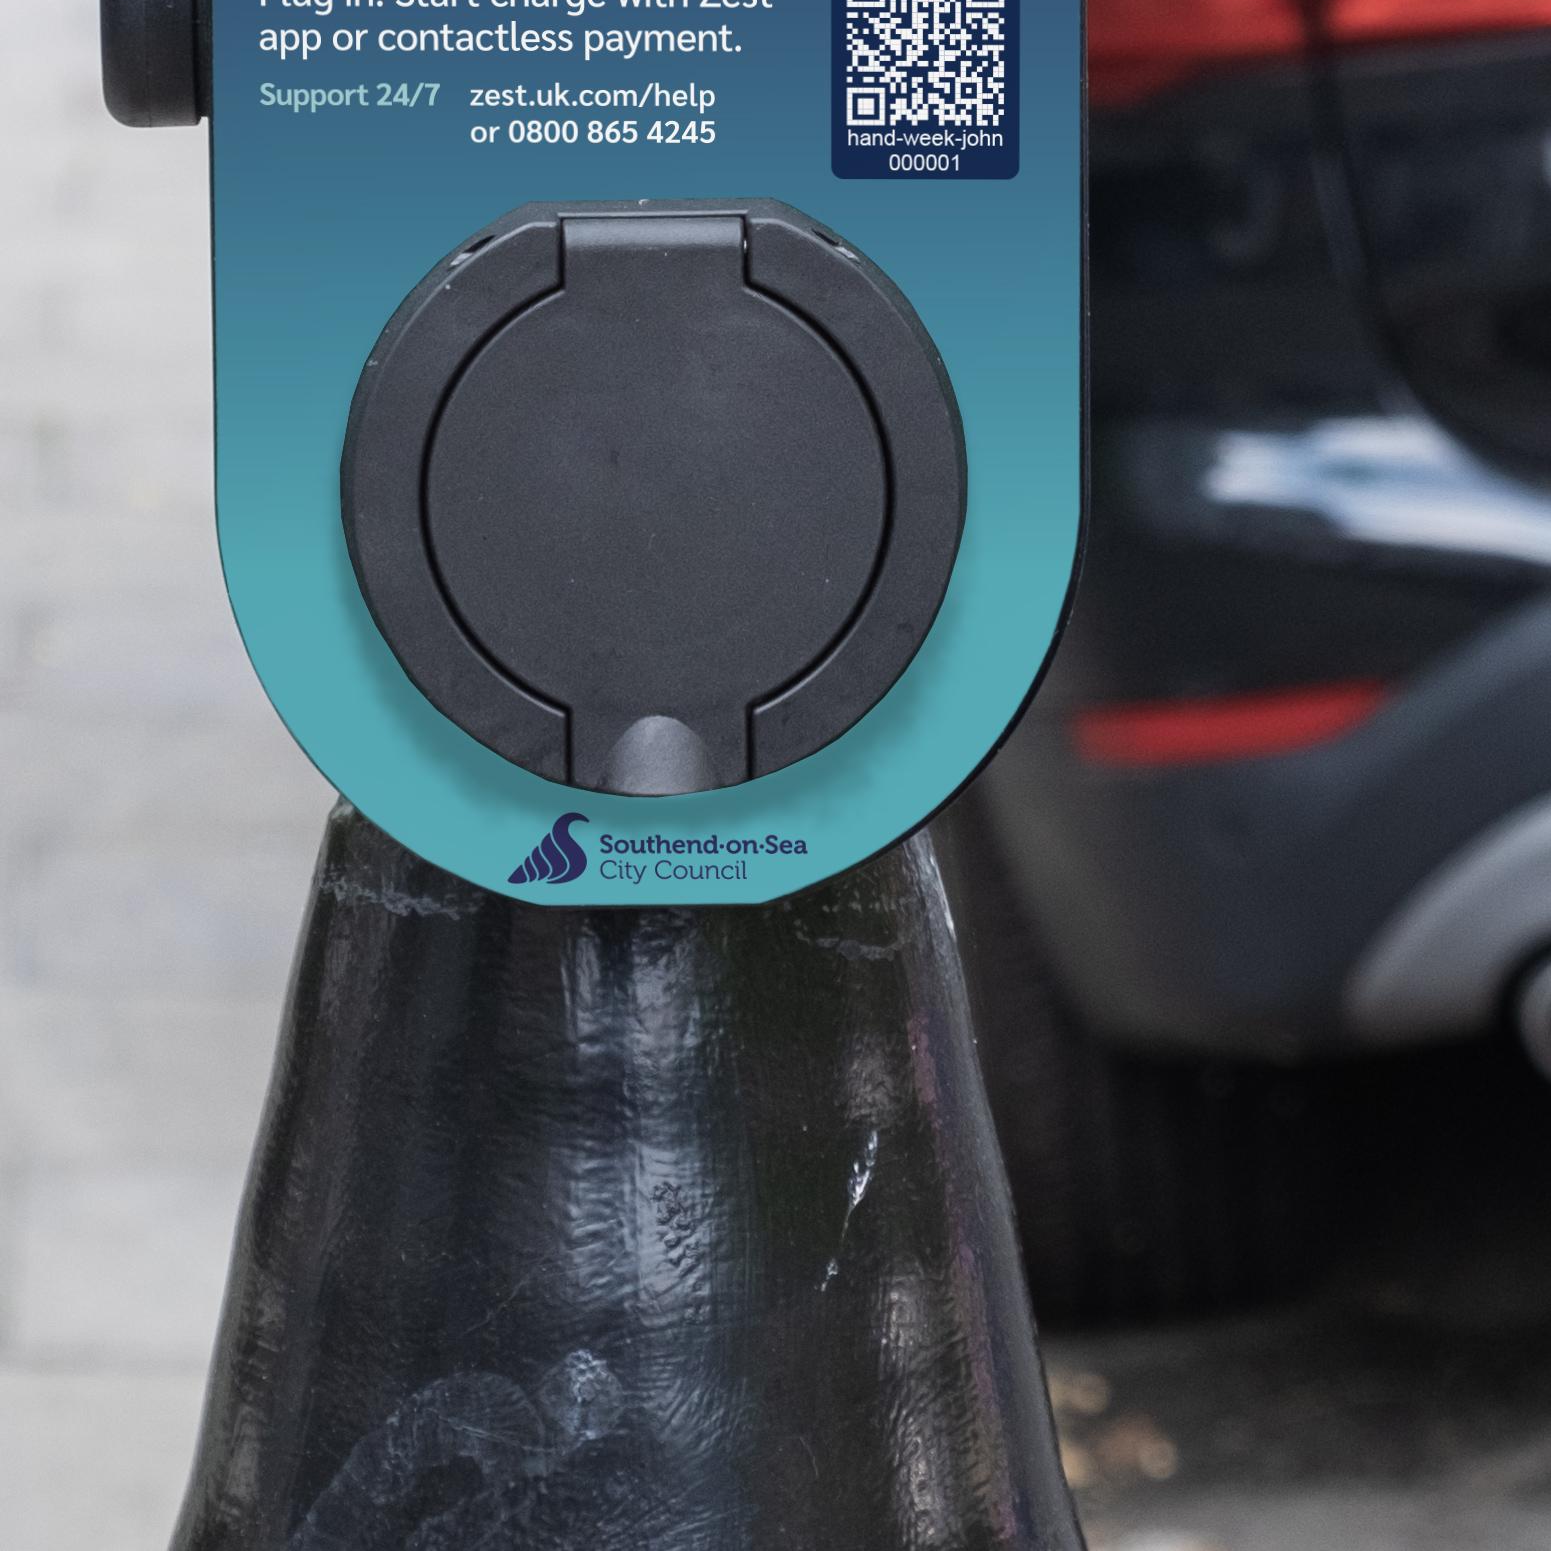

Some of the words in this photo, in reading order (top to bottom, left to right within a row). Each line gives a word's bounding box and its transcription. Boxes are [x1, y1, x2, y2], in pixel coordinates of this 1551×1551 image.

[259, 28, 322, 61] app
[332, 29, 369, 52] or
[378, 20, 574, 52] contactless
[584, 24, 742, 61] payment.
[259, 82, 370, 113] Support
[376, 82, 441, 108] 24/7
[469, 82, 716, 114] zest.uk.com/help
[470, 125, 501, 144] or
[508, 119, 579, 144] 0800
[587, 120, 638, 144] 865
[646, 120, 716, 144] 4245
[847, 128, 1003, 151] hand-week-john
[889, 153, 959, 172] 000001
[599, 859, 647, 886] City
[654, 859, 748, 880] Council
